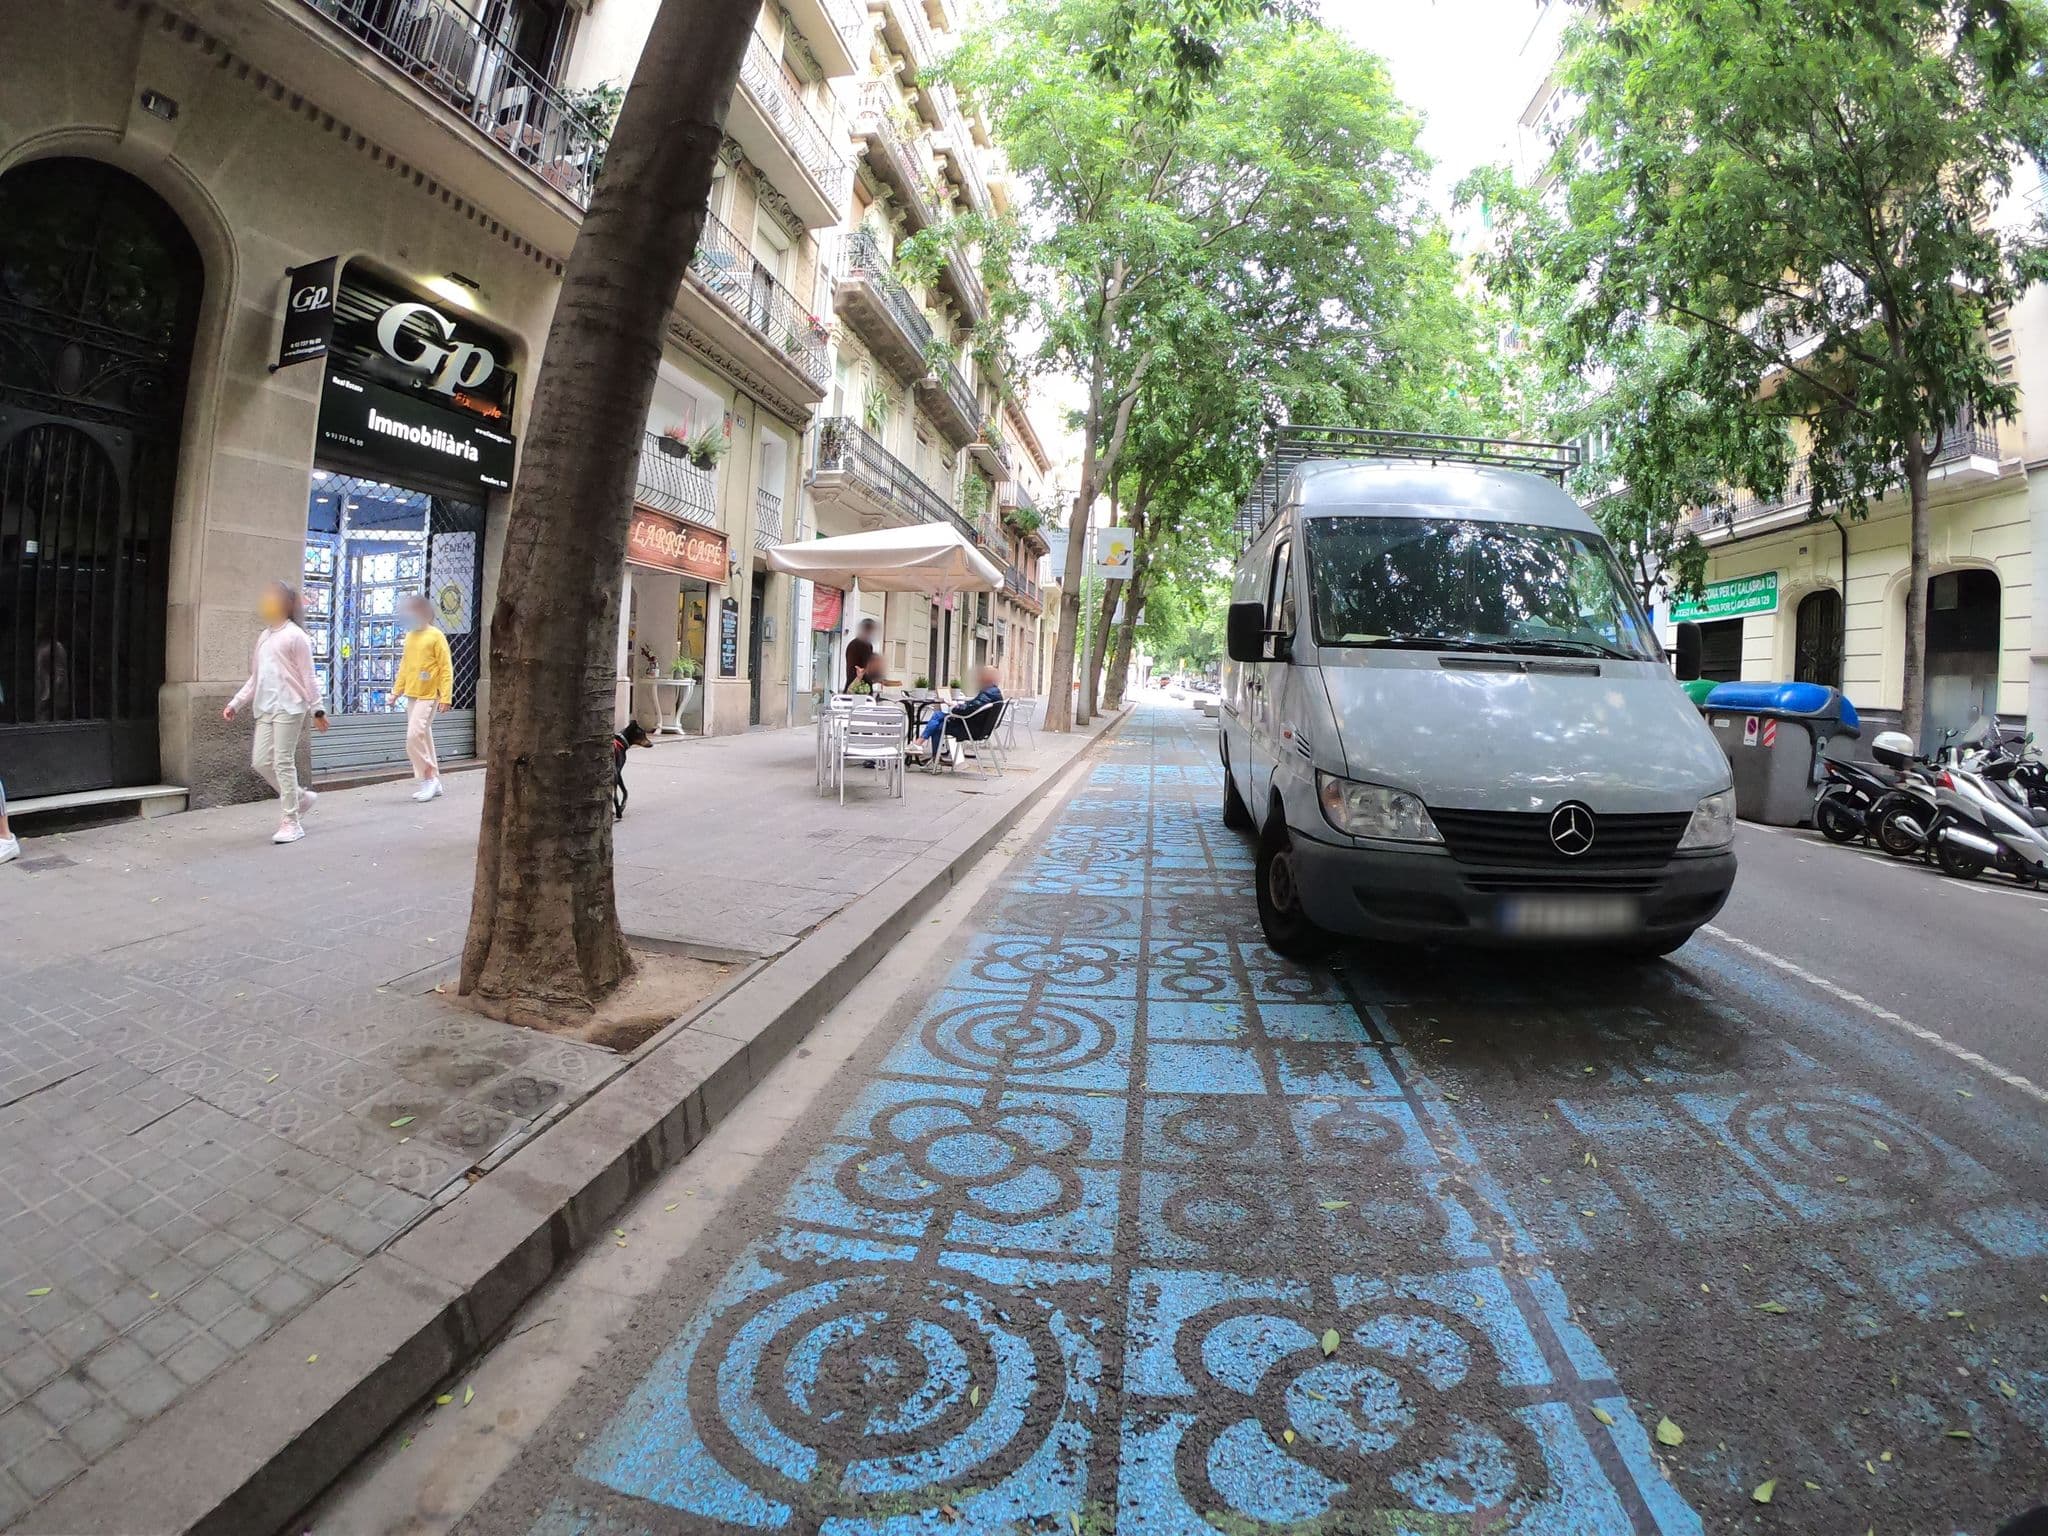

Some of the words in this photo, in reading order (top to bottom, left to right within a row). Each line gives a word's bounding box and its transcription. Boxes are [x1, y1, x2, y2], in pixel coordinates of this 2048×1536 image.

[292, 286, 329, 310] Gp
[377, 302, 494, 396] Gp
[455, 392, 502, 418] Eixple
[368, 407, 479, 462] Immobiliària
[1766, 575, 1777, 589] 129
[1760, 595, 1770, 605] 129
